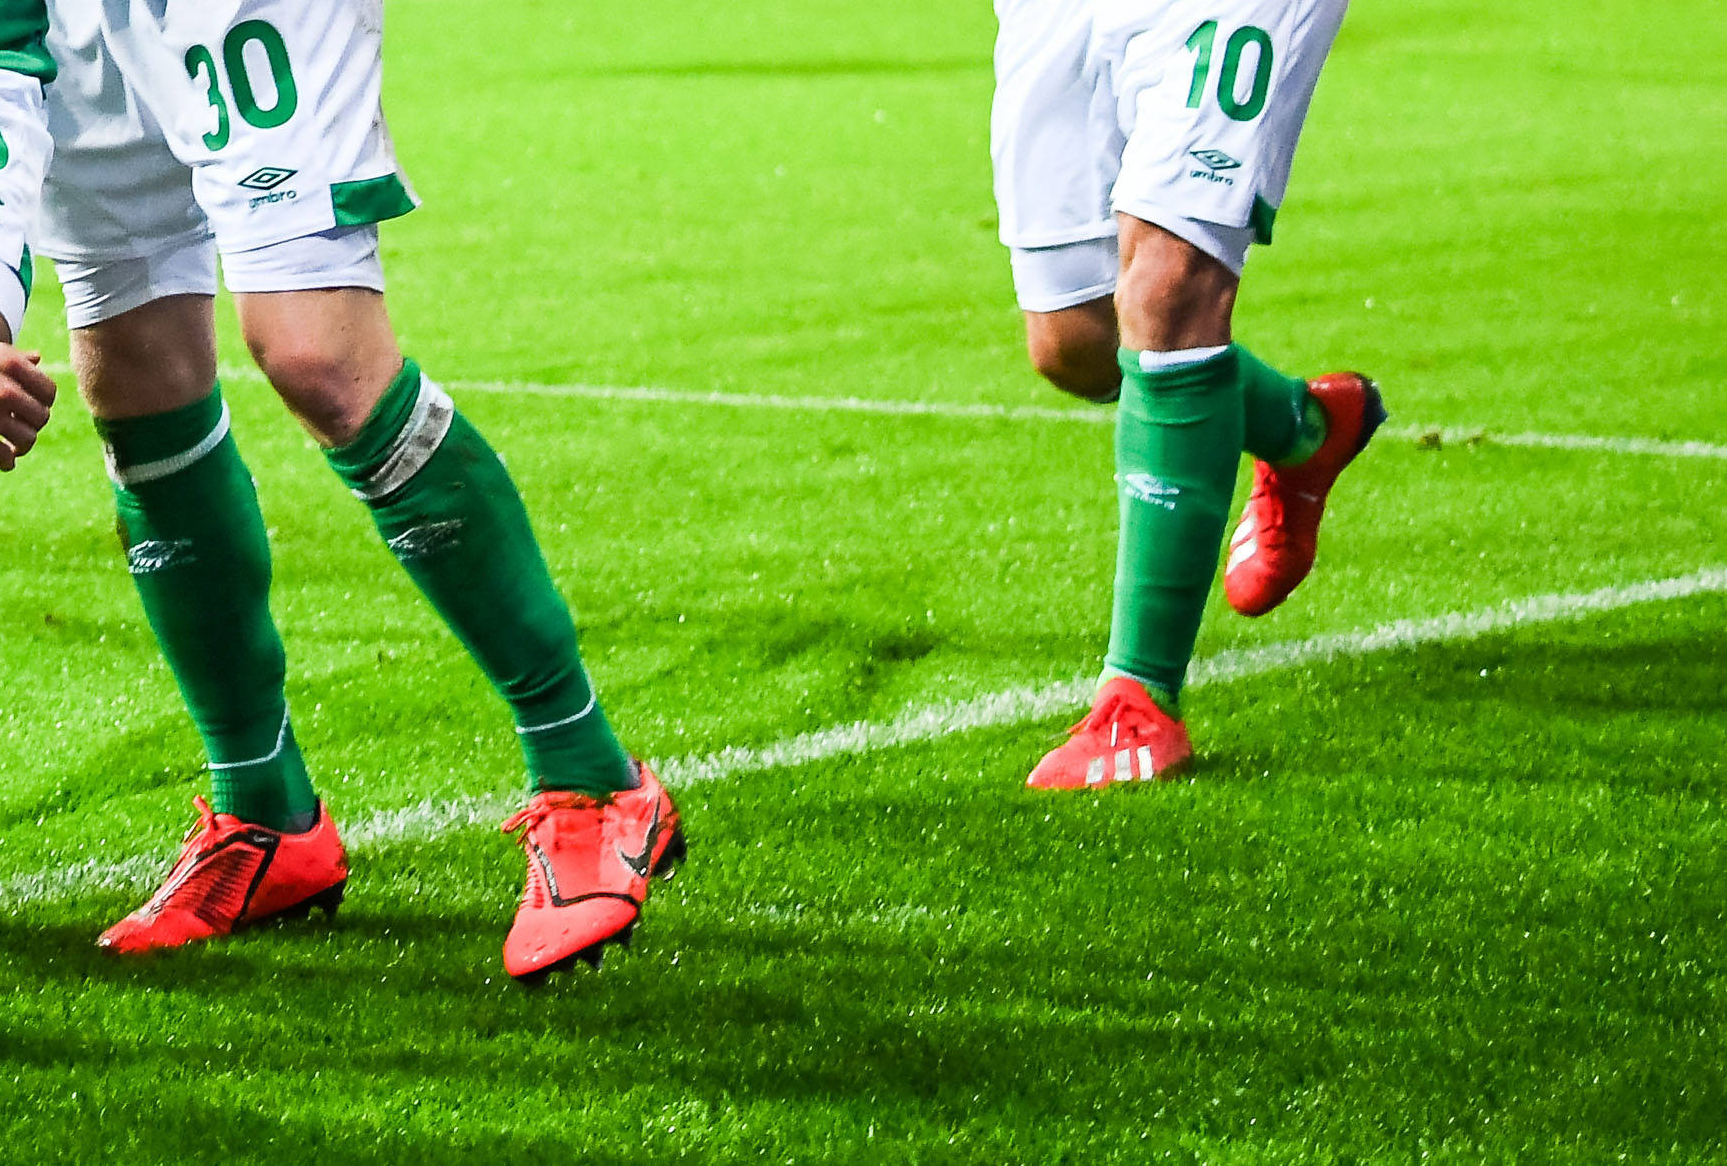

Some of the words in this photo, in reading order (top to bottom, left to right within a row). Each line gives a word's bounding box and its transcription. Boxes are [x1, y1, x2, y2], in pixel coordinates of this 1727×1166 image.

[184, 19, 298, 152] 30
[1185, 19, 1274, 122] 10
[248, 188, 298, 210] umbro
